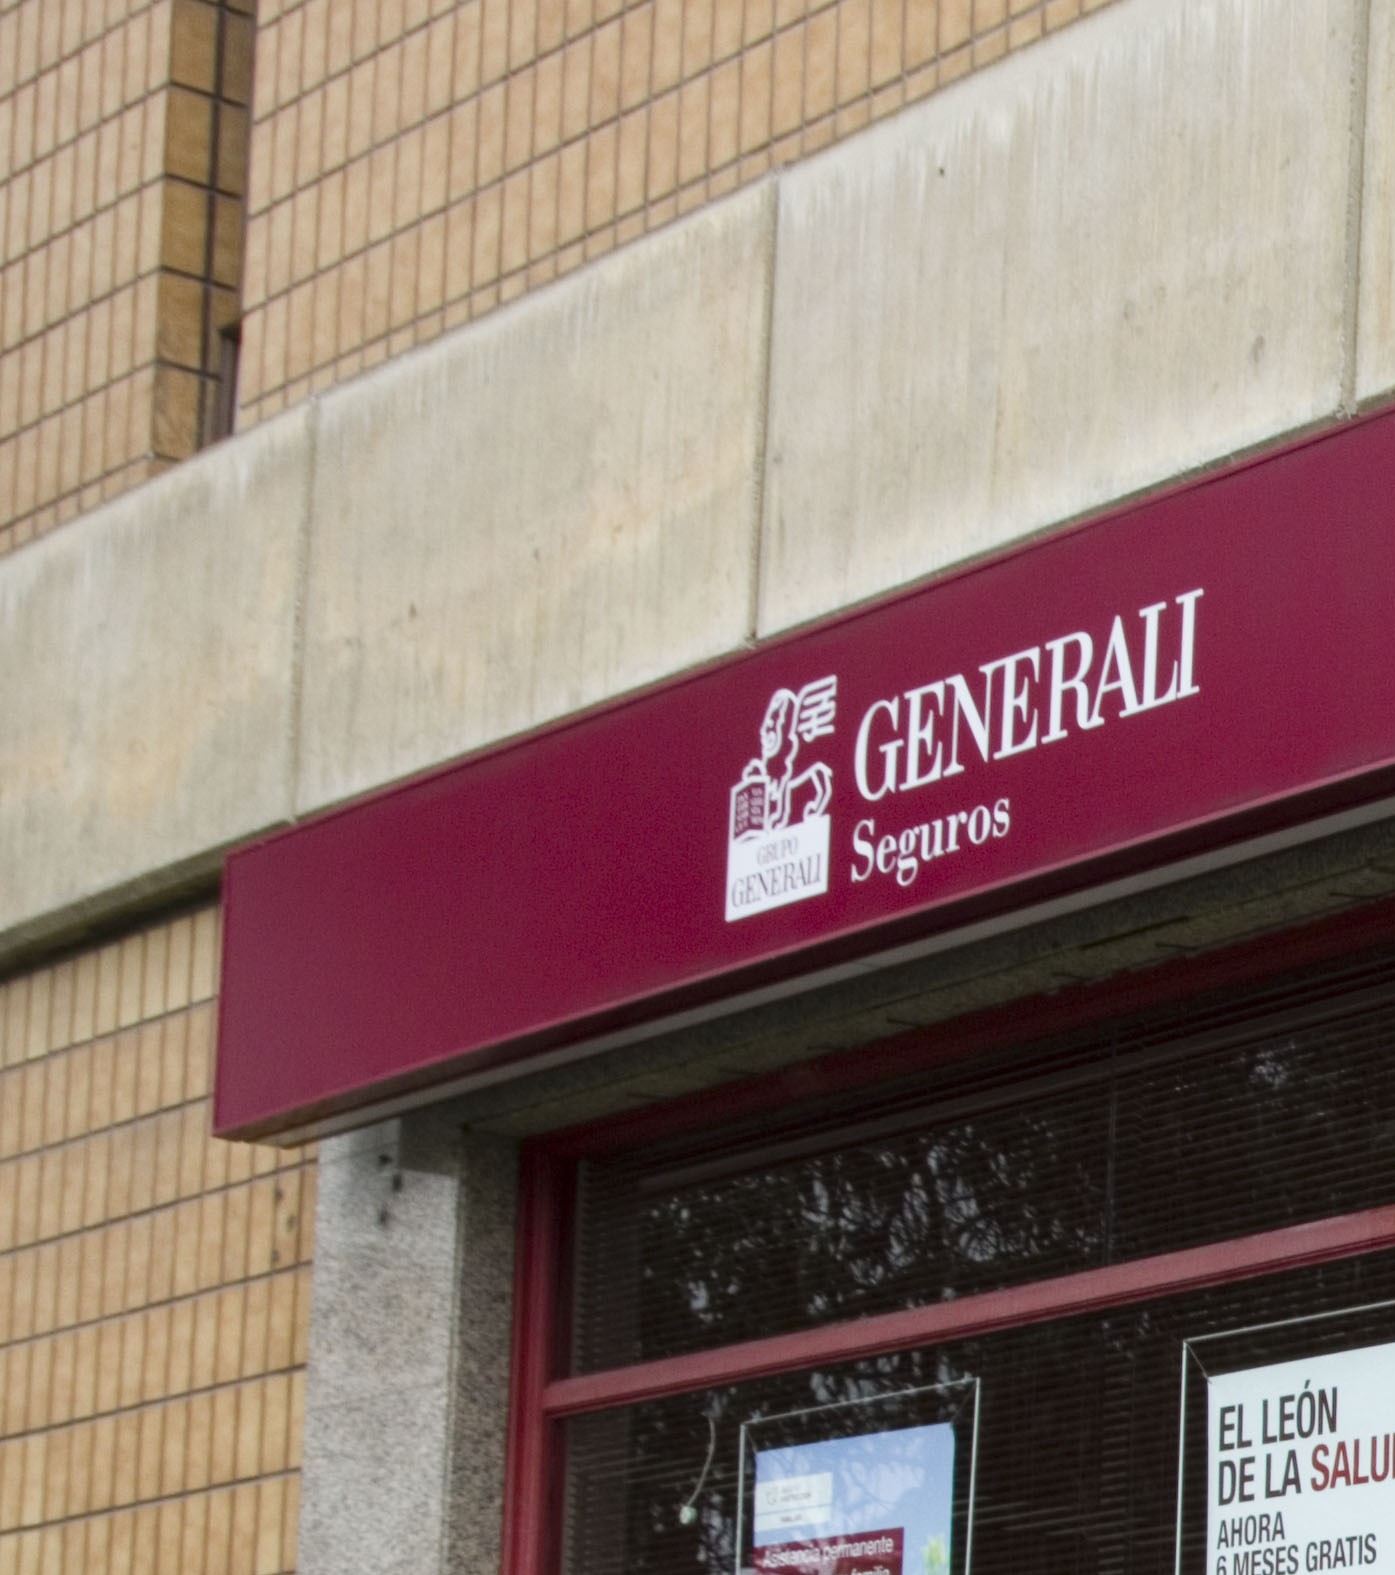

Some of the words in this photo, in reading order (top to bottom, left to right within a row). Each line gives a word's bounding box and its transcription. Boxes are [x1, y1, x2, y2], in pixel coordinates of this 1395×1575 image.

[853, 588, 1204, 801] GENERALI
[757, 836, 799, 865] GRUPO
[850, 798, 1011, 886] Seguros
[731, 853, 821, 908] GENERALI
[1218, 1403, 1252, 1451] EL
[1262, 1379, 1338, 1445] LEÓN
[1218, 1456, 1255, 1506] DE
[1265, 1449, 1301, 1498] LA
[823, 1536, 893, 1562] permanente
[1216, 1555, 1227, 1575] 6
[1233, 1544, 1299, 1575] MESES
[1305, 1533, 1377, 1572] GRATIS
[1217, 1511, 1285, 1549] AHORA
